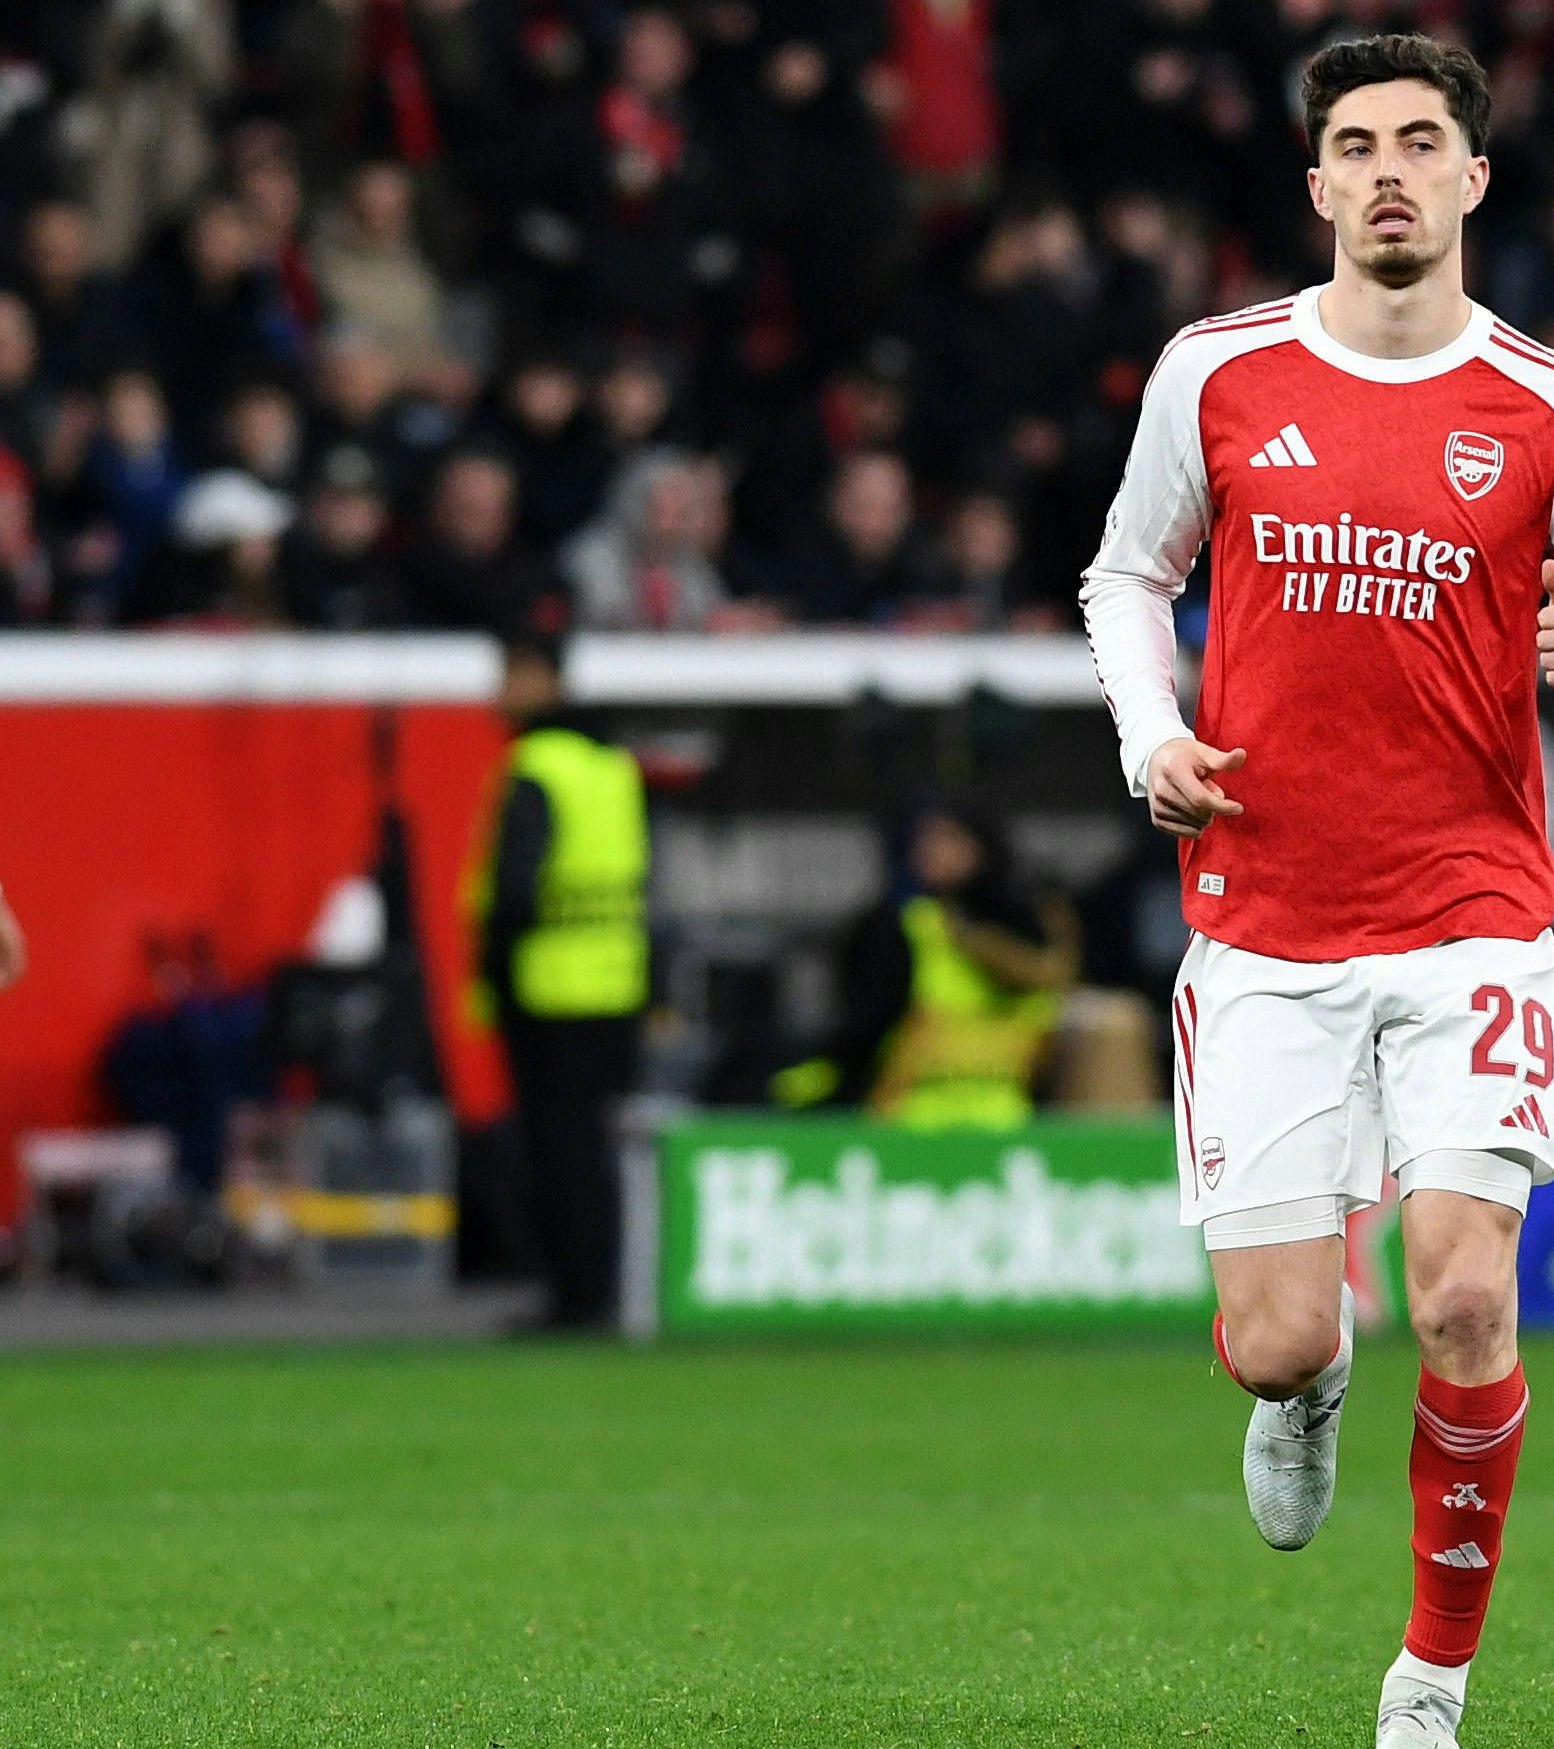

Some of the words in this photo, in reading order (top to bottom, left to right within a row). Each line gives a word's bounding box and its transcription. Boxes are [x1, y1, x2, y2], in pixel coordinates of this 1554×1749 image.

[1454, 441, 1497, 461] Arsenal
[1250, 512, 1476, 584] Emirates
[1282, 571, 1330, 612] FLY
[1335, 573, 1438, 621] BETTER
[1469, 982, 1554, 1090] 29
[696, 1147, 1203, 1304] Heineken
